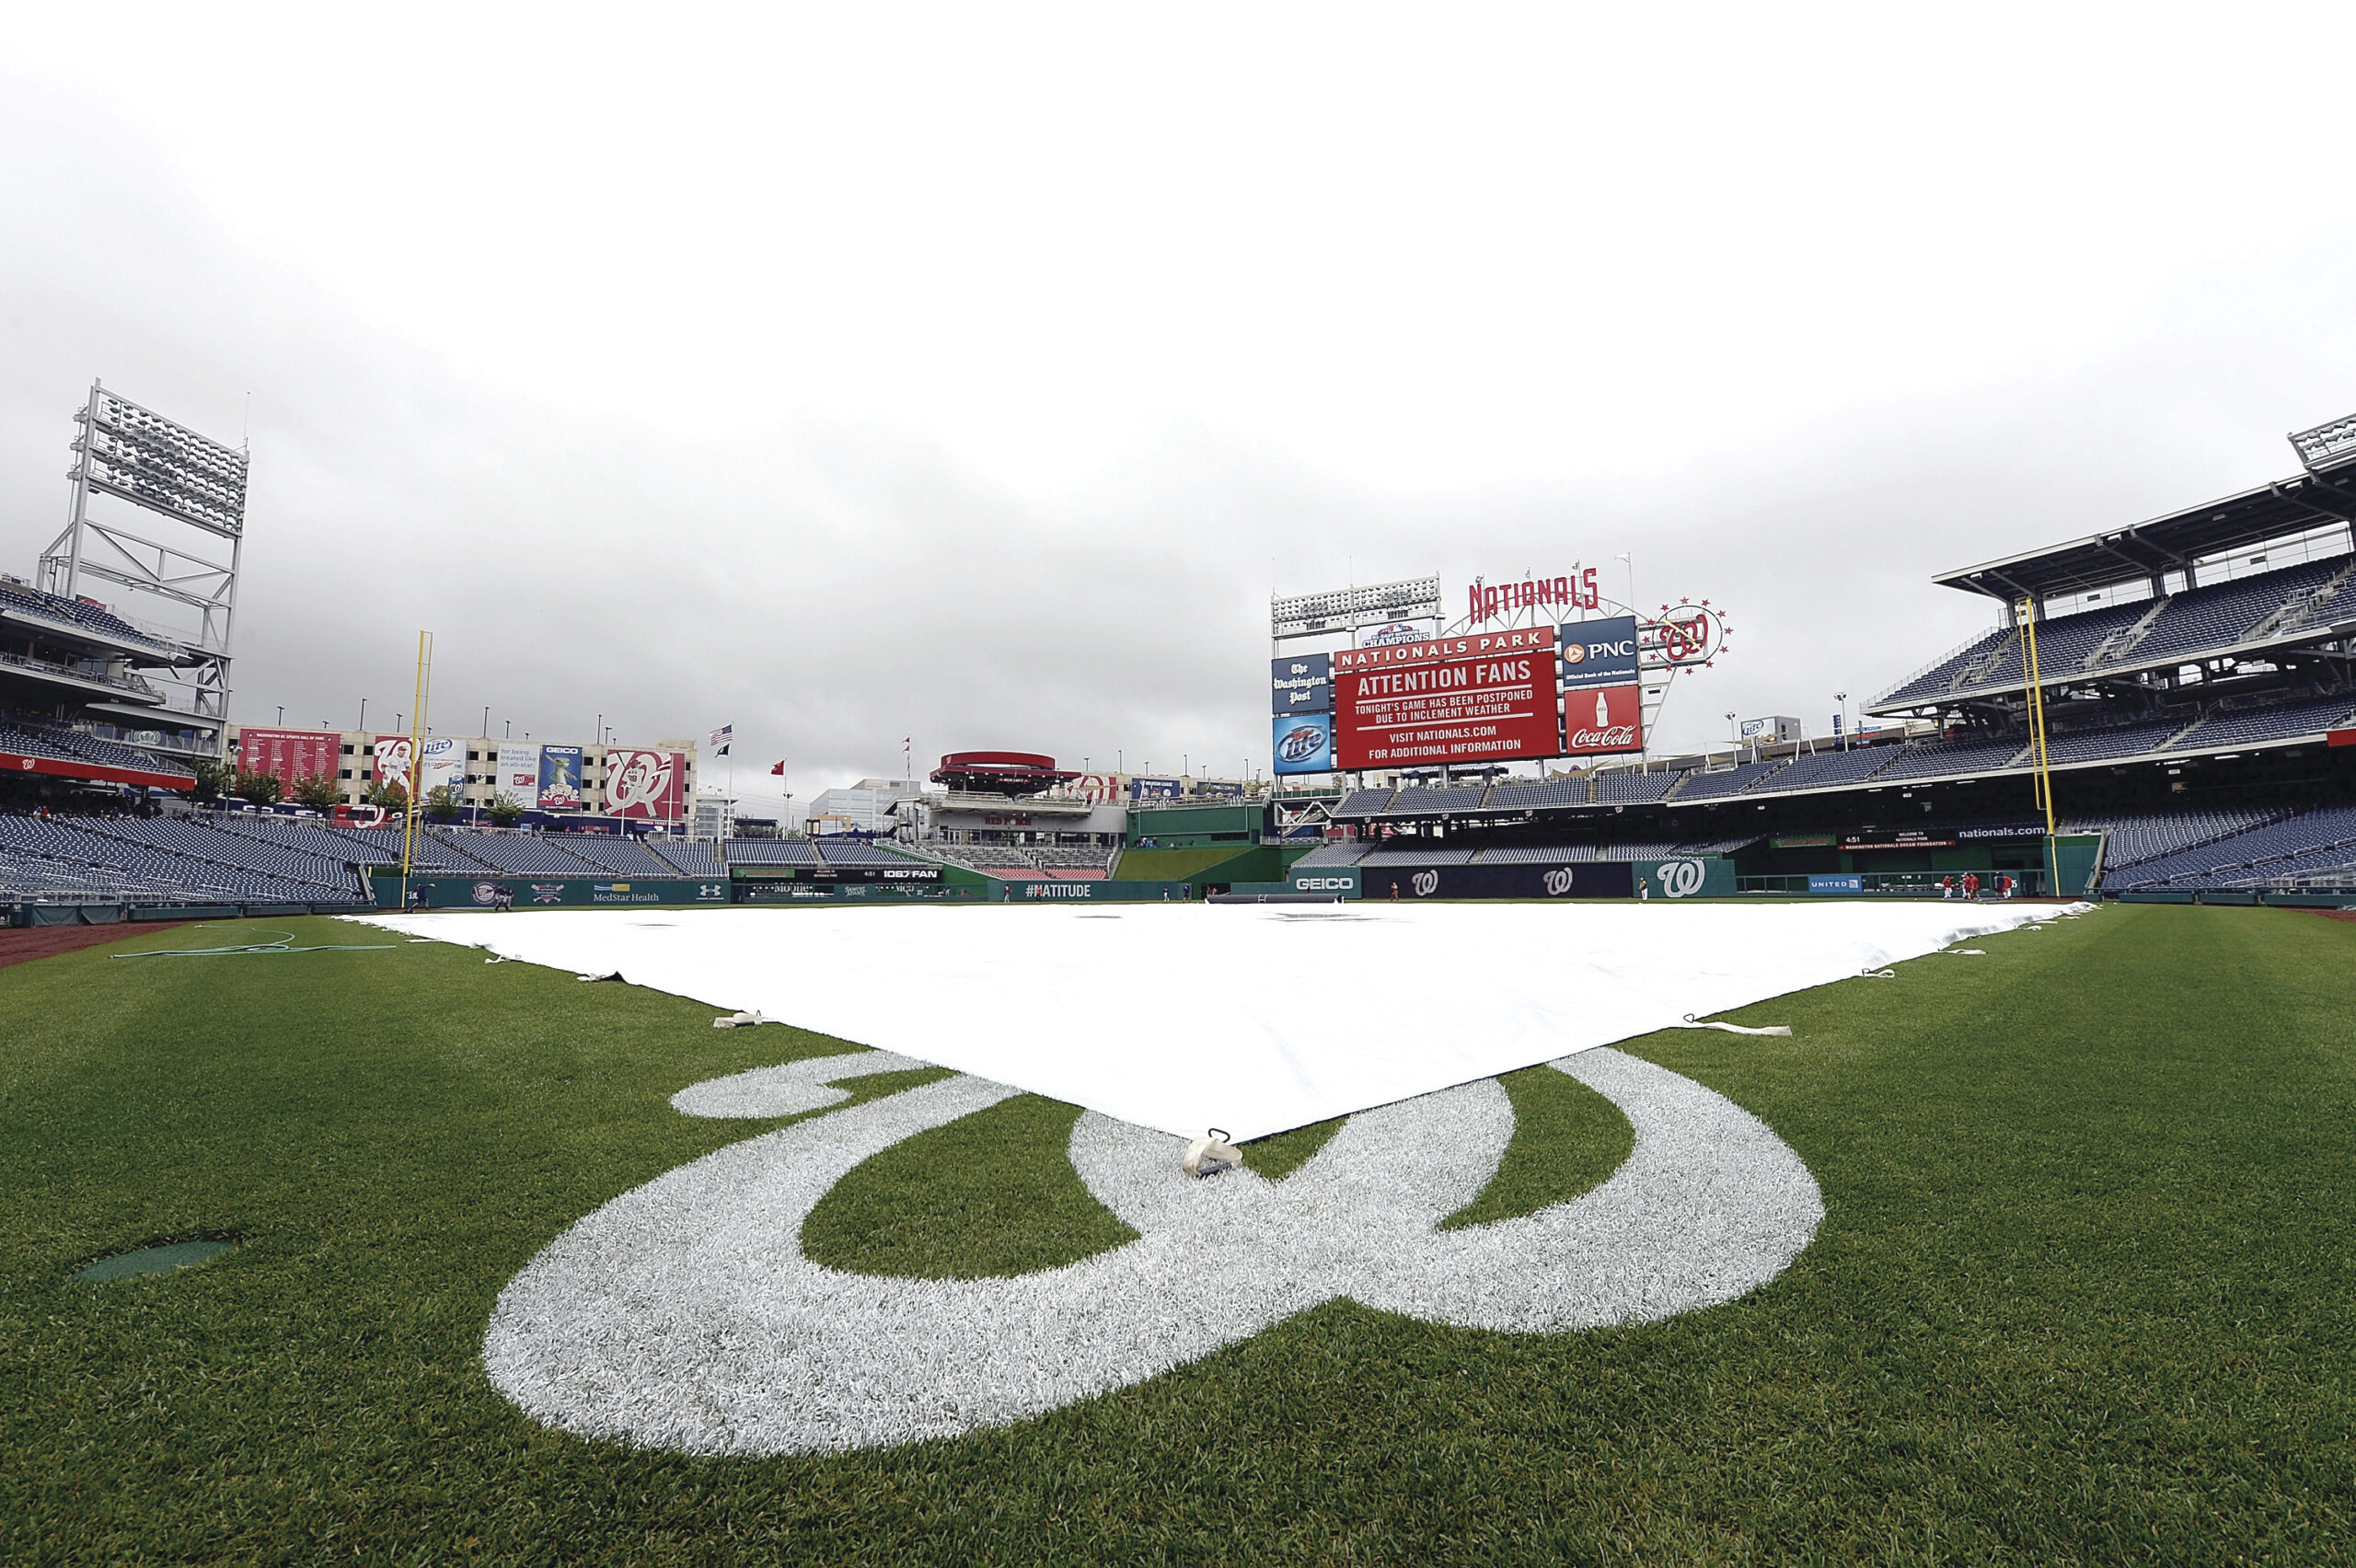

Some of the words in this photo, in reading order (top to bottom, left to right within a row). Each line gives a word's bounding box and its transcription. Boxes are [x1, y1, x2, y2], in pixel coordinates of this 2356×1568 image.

[1469, 568, 1598, 624] NATIONALS
[1341, 641, 1468, 667] NATIONALS
[1480, 632, 1541, 651] PARK
[1363, 632, 1429, 648] CHAMPIONS
[1587, 640, 1634, 659] PNC
[1291, 663, 1308, 674] The
[1358, 667, 1467, 696] ATTENTION
[1476, 660, 1531, 685] FANS
[1273, 675, 1327, 690] Washington
[1289, 691, 1311, 705] Post
[1355, 702, 1400, 715] TONIGHT'S
[1402, 700, 1426, 711] GAME
[1429, 697, 1447, 709] HAS
[1450, 695, 1473, 707] BEEN
[1477, 690, 1533, 704] POSTPONED
[1376, 713, 1393, 724] DUE
[1396, 711, 1407, 722] TO
[1410, 707, 1463, 721] INCLEMENT
[1465, 703, 1510, 716] WEATHER
[1390, 732, 1415, 743] VISIT
[1417, 726, 1496, 741] NATIONALS.COM
[1572, 725, 1637, 749] Coca-Cola
[1369, 749, 1388, 760] FOR
[1390, 745, 1448, 758] ADDITIONAL
[1451, 739, 1521, 754] INFORMATION
[1959, 825, 2046, 839] nationals.com
[1296, 877, 1354, 890] GEICO
[1412, 869, 1439, 896] W
[1543, 867, 1573, 895] W
[1657, 860, 1705, 898] W
[593, 893, 630, 902] MedStar
[632, 893, 659, 901] Health
